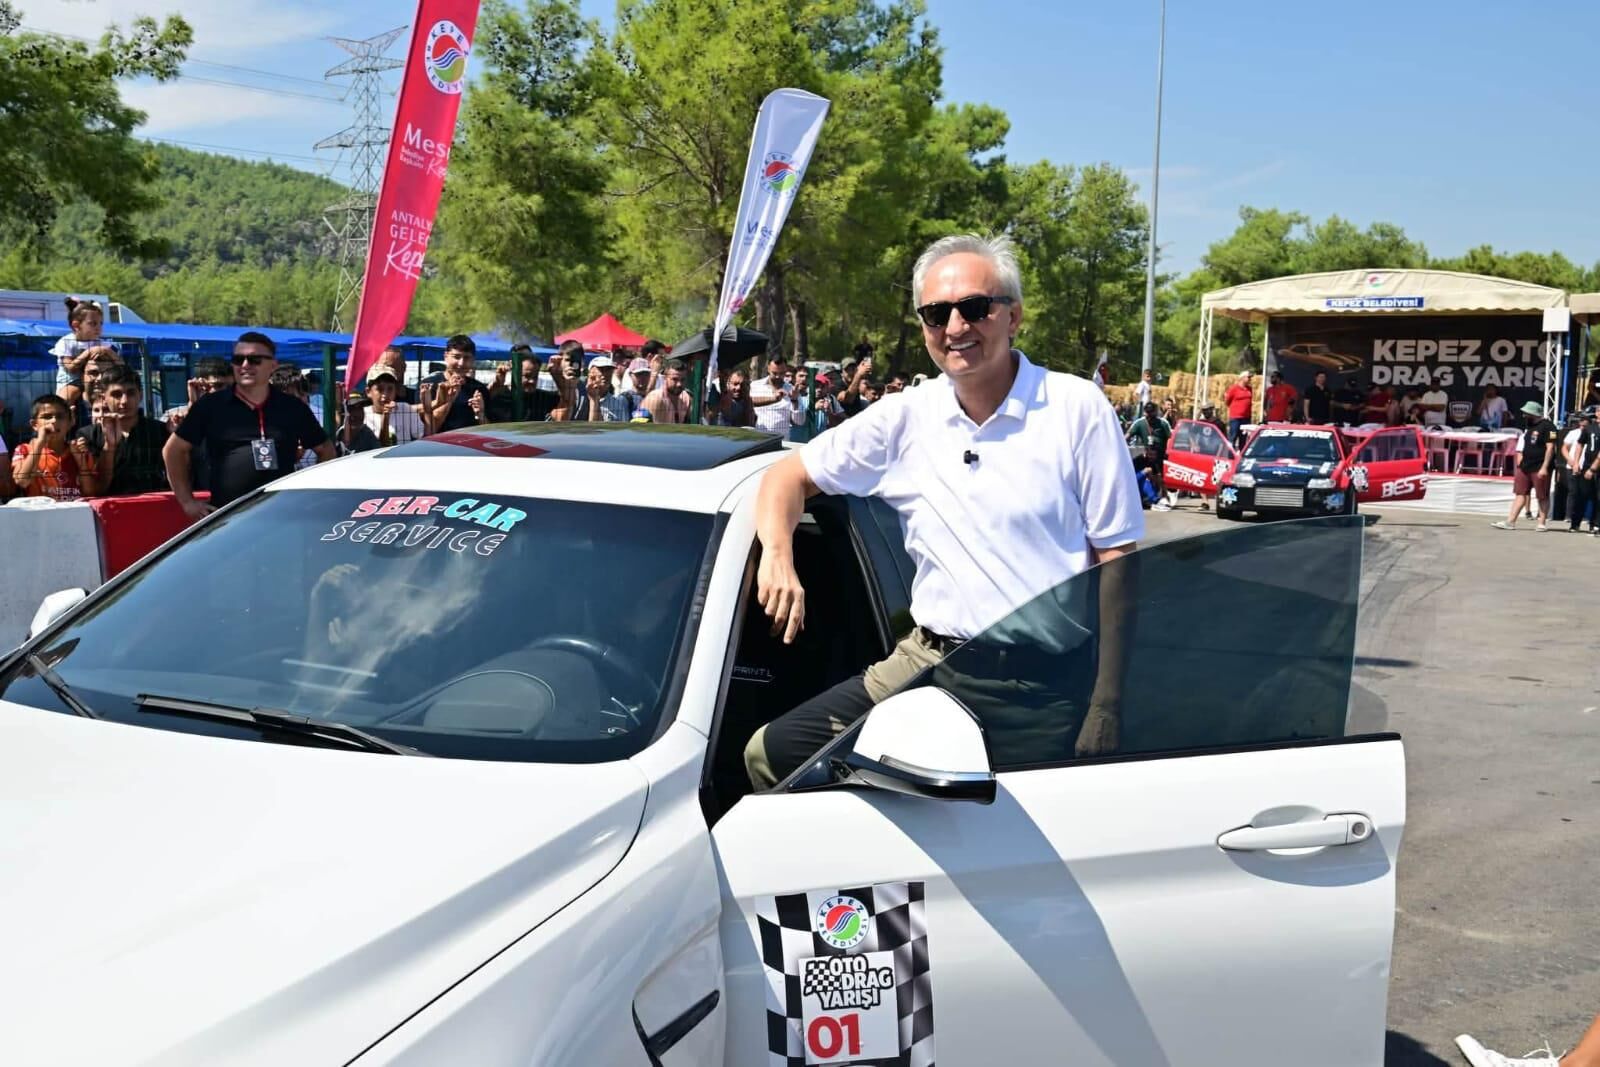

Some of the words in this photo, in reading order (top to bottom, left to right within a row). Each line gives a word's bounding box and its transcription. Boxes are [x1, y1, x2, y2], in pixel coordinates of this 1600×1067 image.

[403, 121, 451, 161] Mes
[1331, 299, 1364, 307] KEPEZ
[1373, 339, 1482, 362] KEPEZ
[1372, 365, 1454, 387] DRAG
[351, 496, 527, 532] SER-CAR
[320, 520, 507, 556] SERVICE
[820, 898, 864, 917] KEPEZ
[829, 956, 867, 976] OTO
[841, 969, 892, 990] DRAG
[819, 988, 879, 1009] YARIŞI
[807, 1013, 860, 1058] 01
